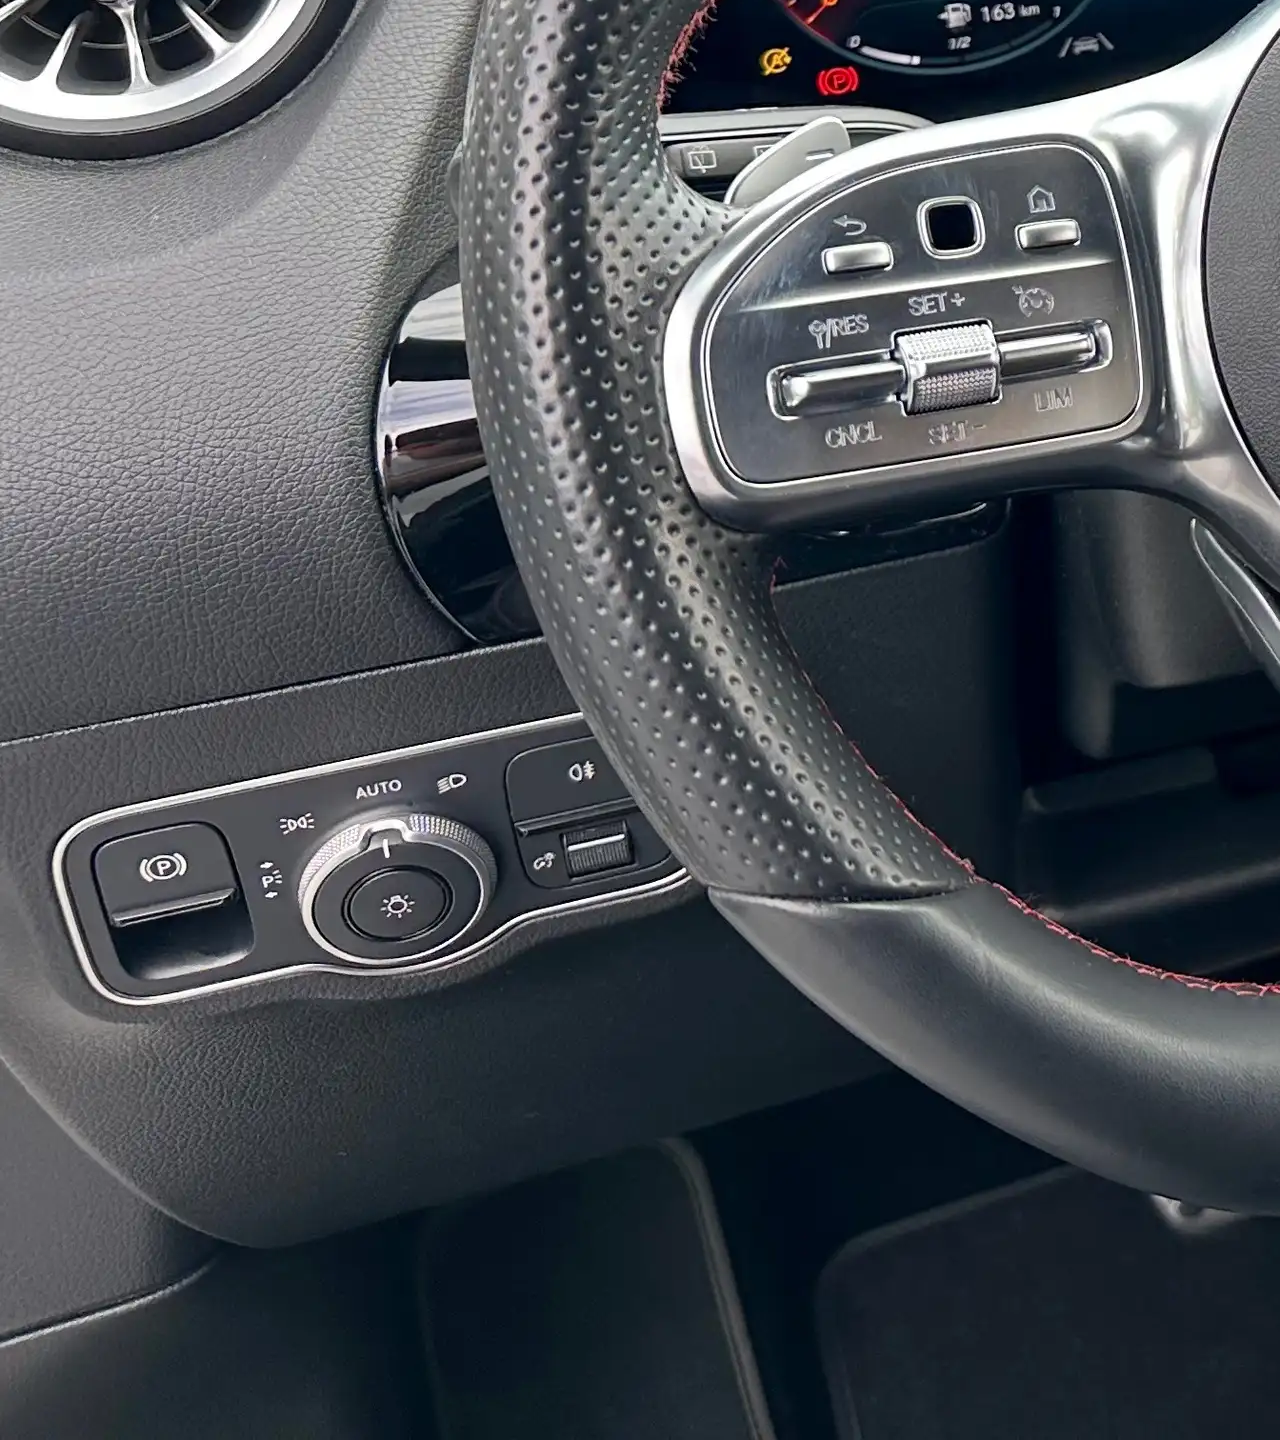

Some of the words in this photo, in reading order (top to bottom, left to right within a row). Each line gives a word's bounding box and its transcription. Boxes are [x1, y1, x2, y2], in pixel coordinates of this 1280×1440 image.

[980, 2, 1016, 23] 163
[947, 35, 972, 50] 1/2
[355, 778, 403, 800] AUTO
